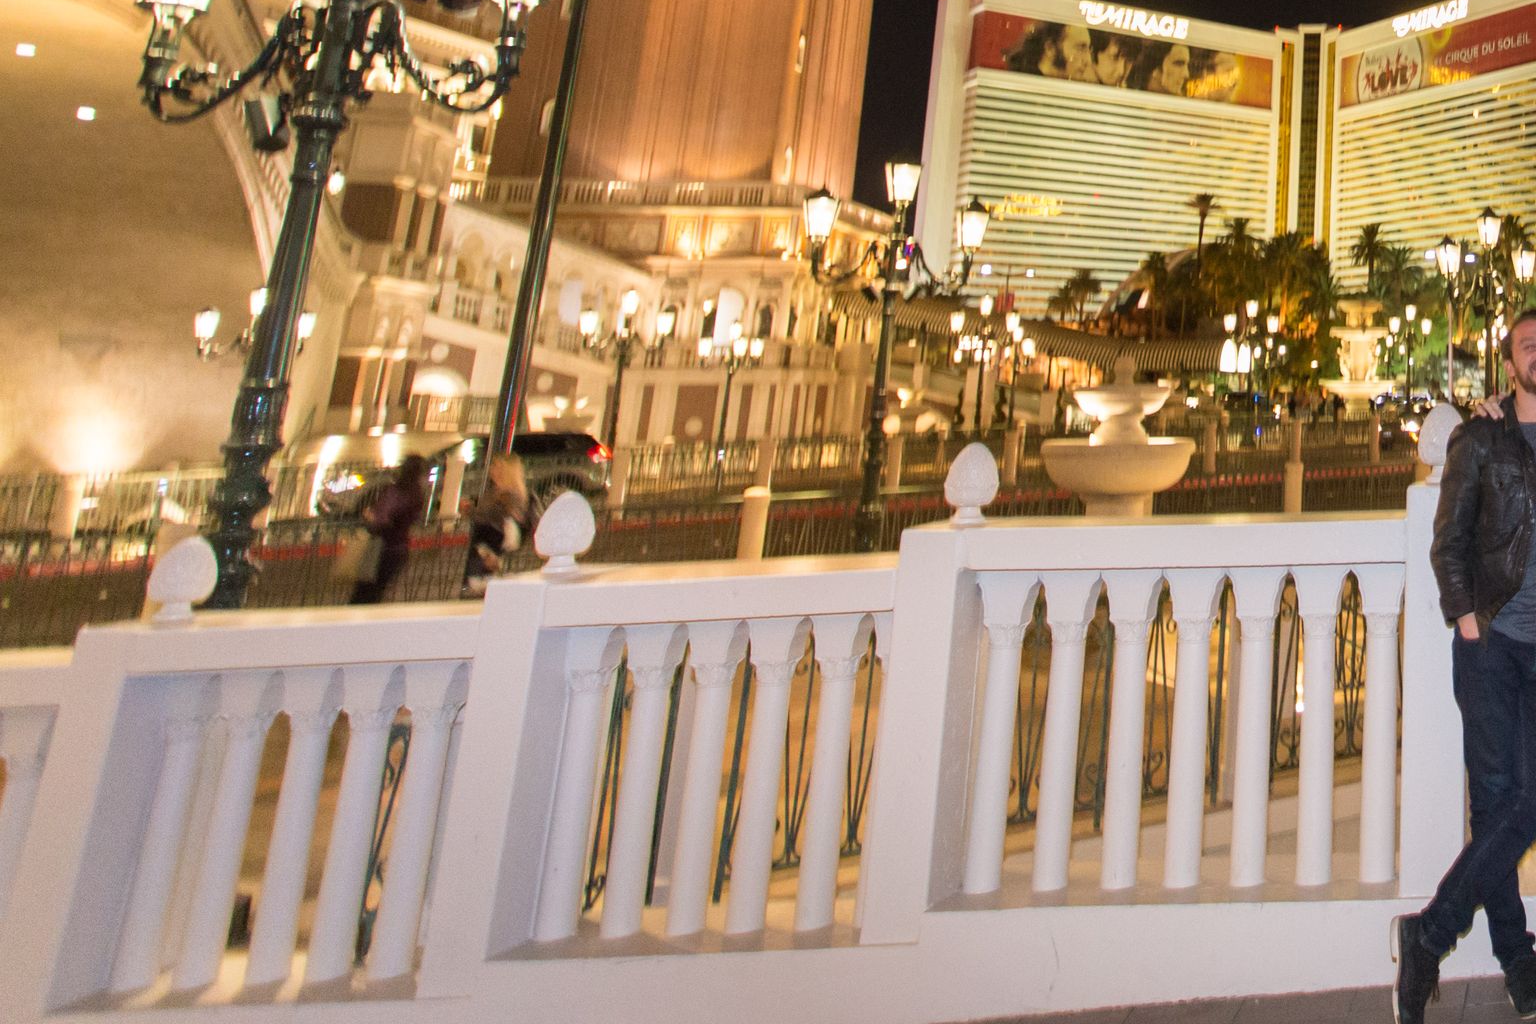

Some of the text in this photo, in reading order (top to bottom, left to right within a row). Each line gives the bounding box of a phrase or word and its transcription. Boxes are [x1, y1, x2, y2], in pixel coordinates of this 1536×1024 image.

[1104, 5, 1190, 39] MIRAGE
[1445, 43, 1480, 65] CIRQUE
[1481, 41, 1496, 56] DU
[1497, 32, 1532, 52] SOLEIL
